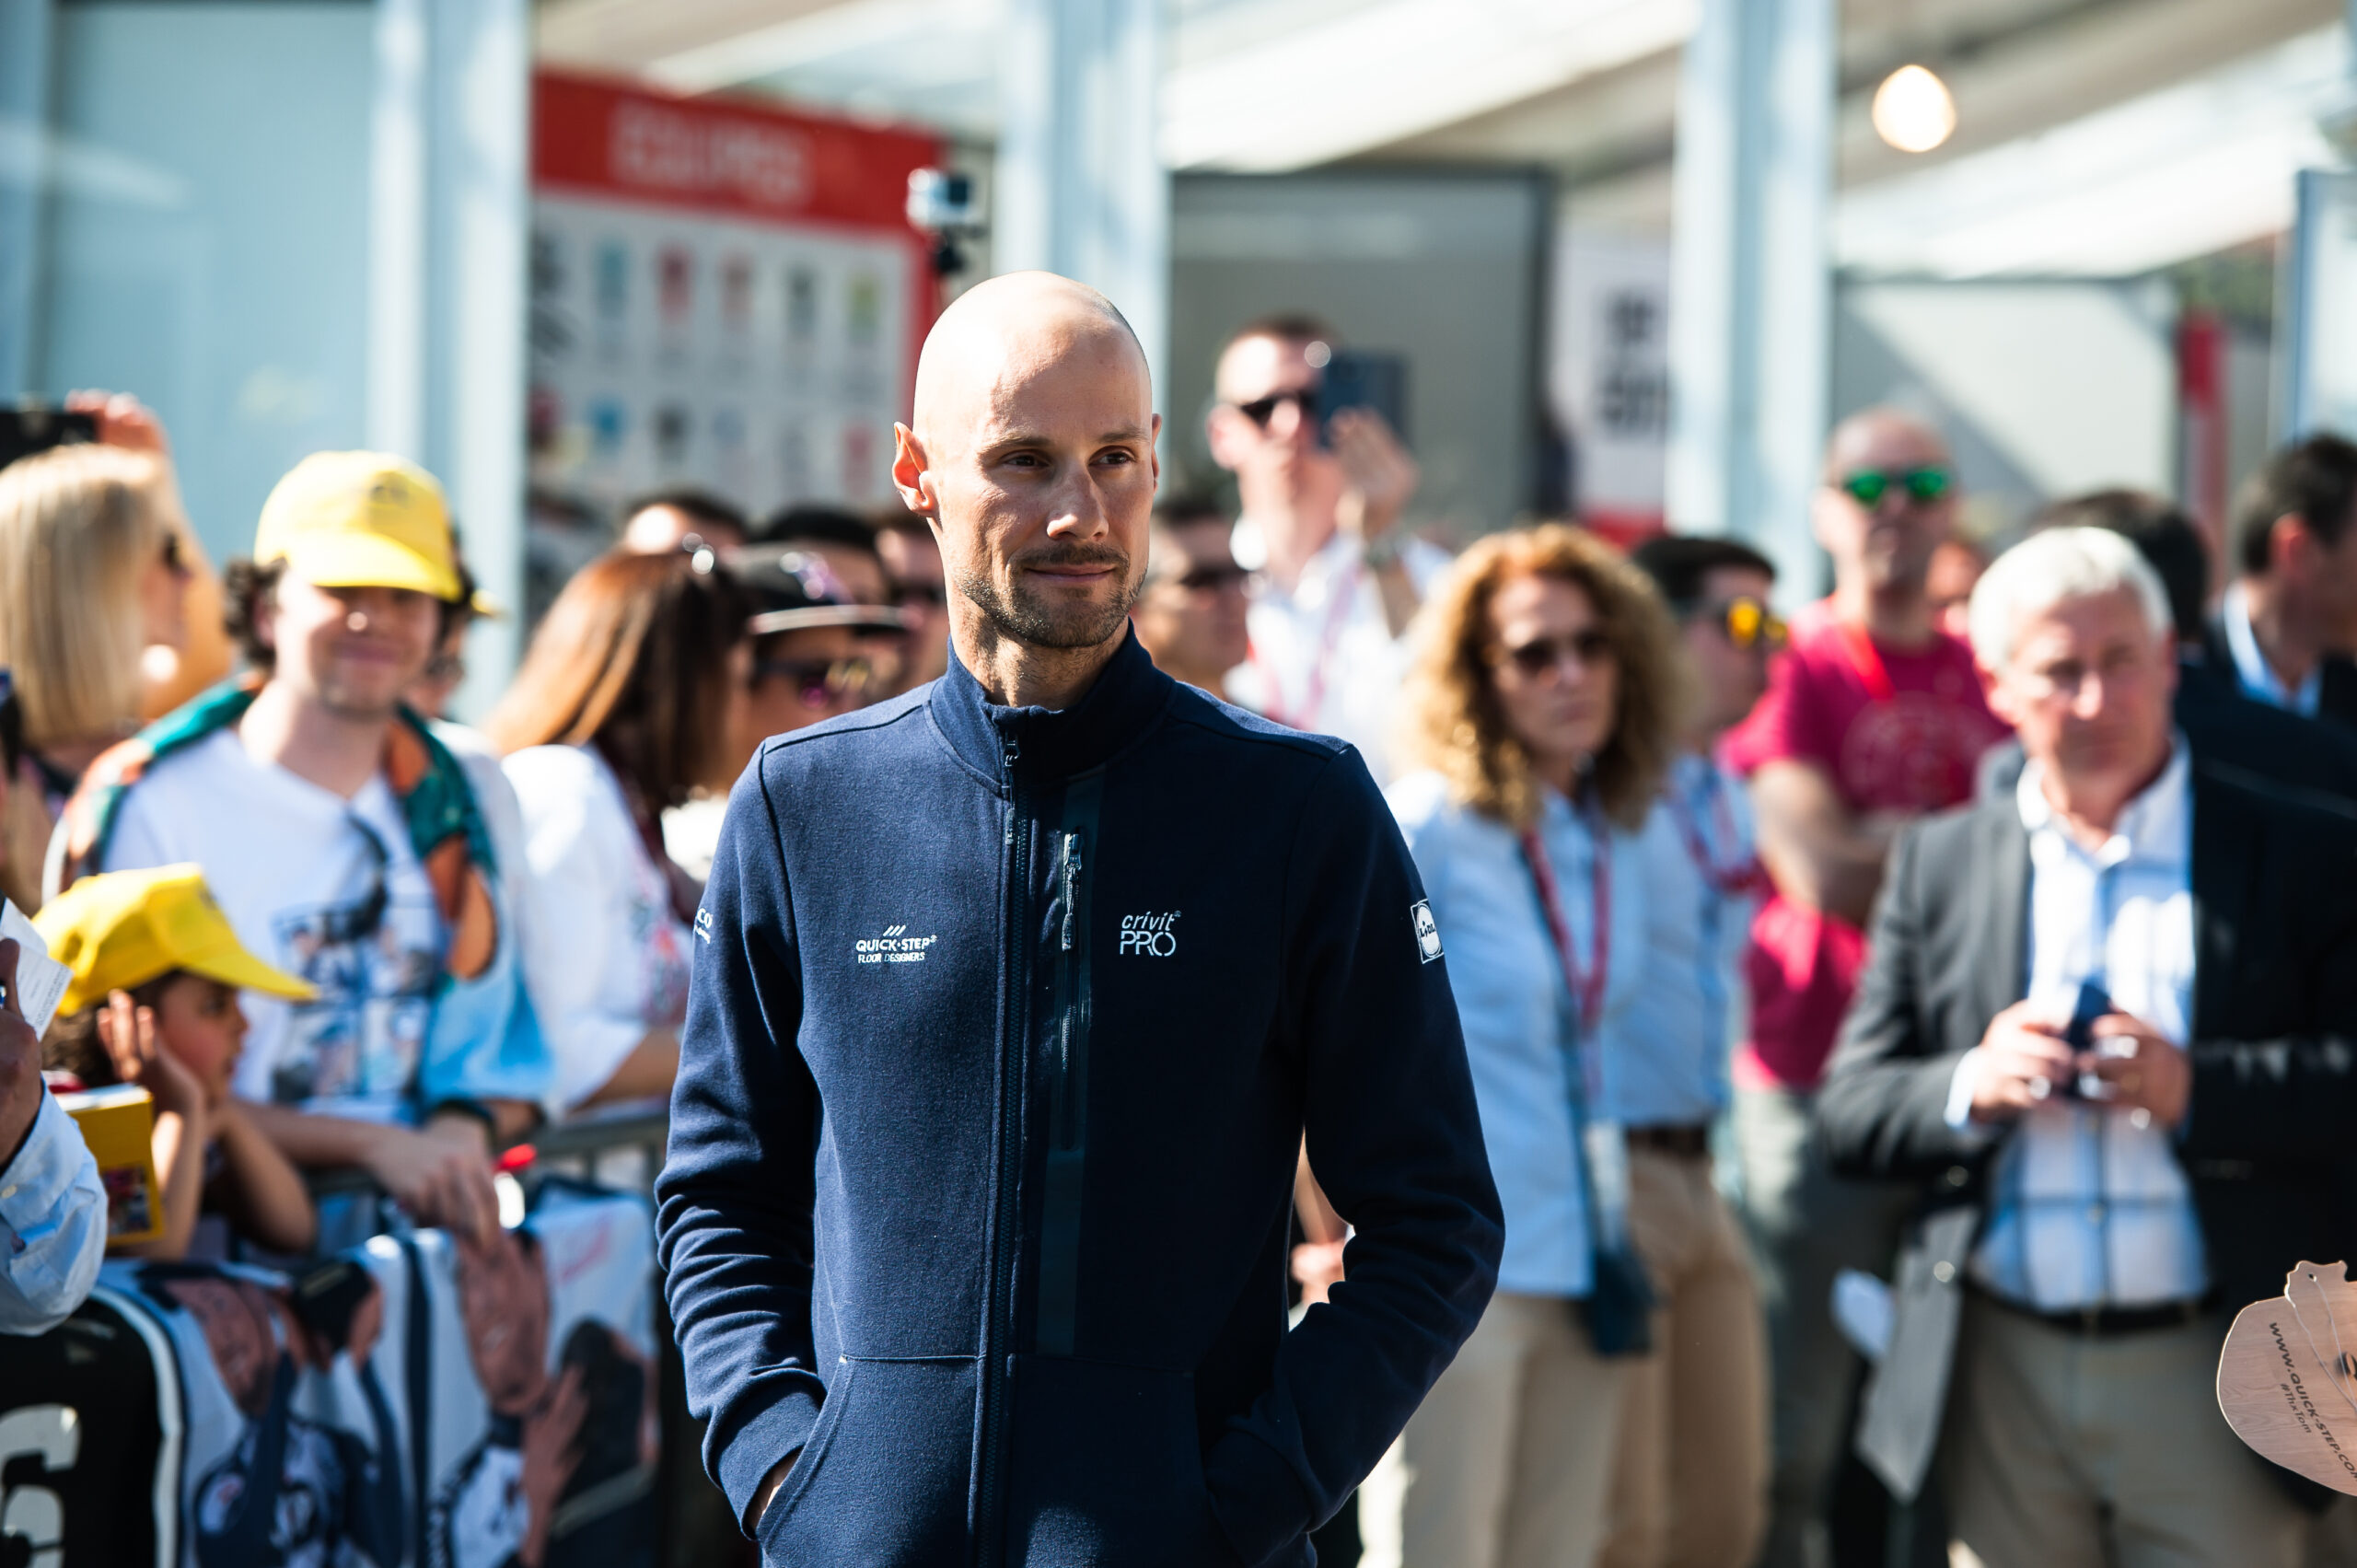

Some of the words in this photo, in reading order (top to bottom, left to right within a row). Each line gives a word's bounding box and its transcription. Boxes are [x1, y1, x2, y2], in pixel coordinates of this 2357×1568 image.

[697, 908, 713, 928] CO
[1120, 930, 1177, 957] PRO
[857, 953, 882, 964] FLOOR
[885, 952, 925, 963] DESIGNERS
[2281, 1383, 2312, 1434] #ThxTom
